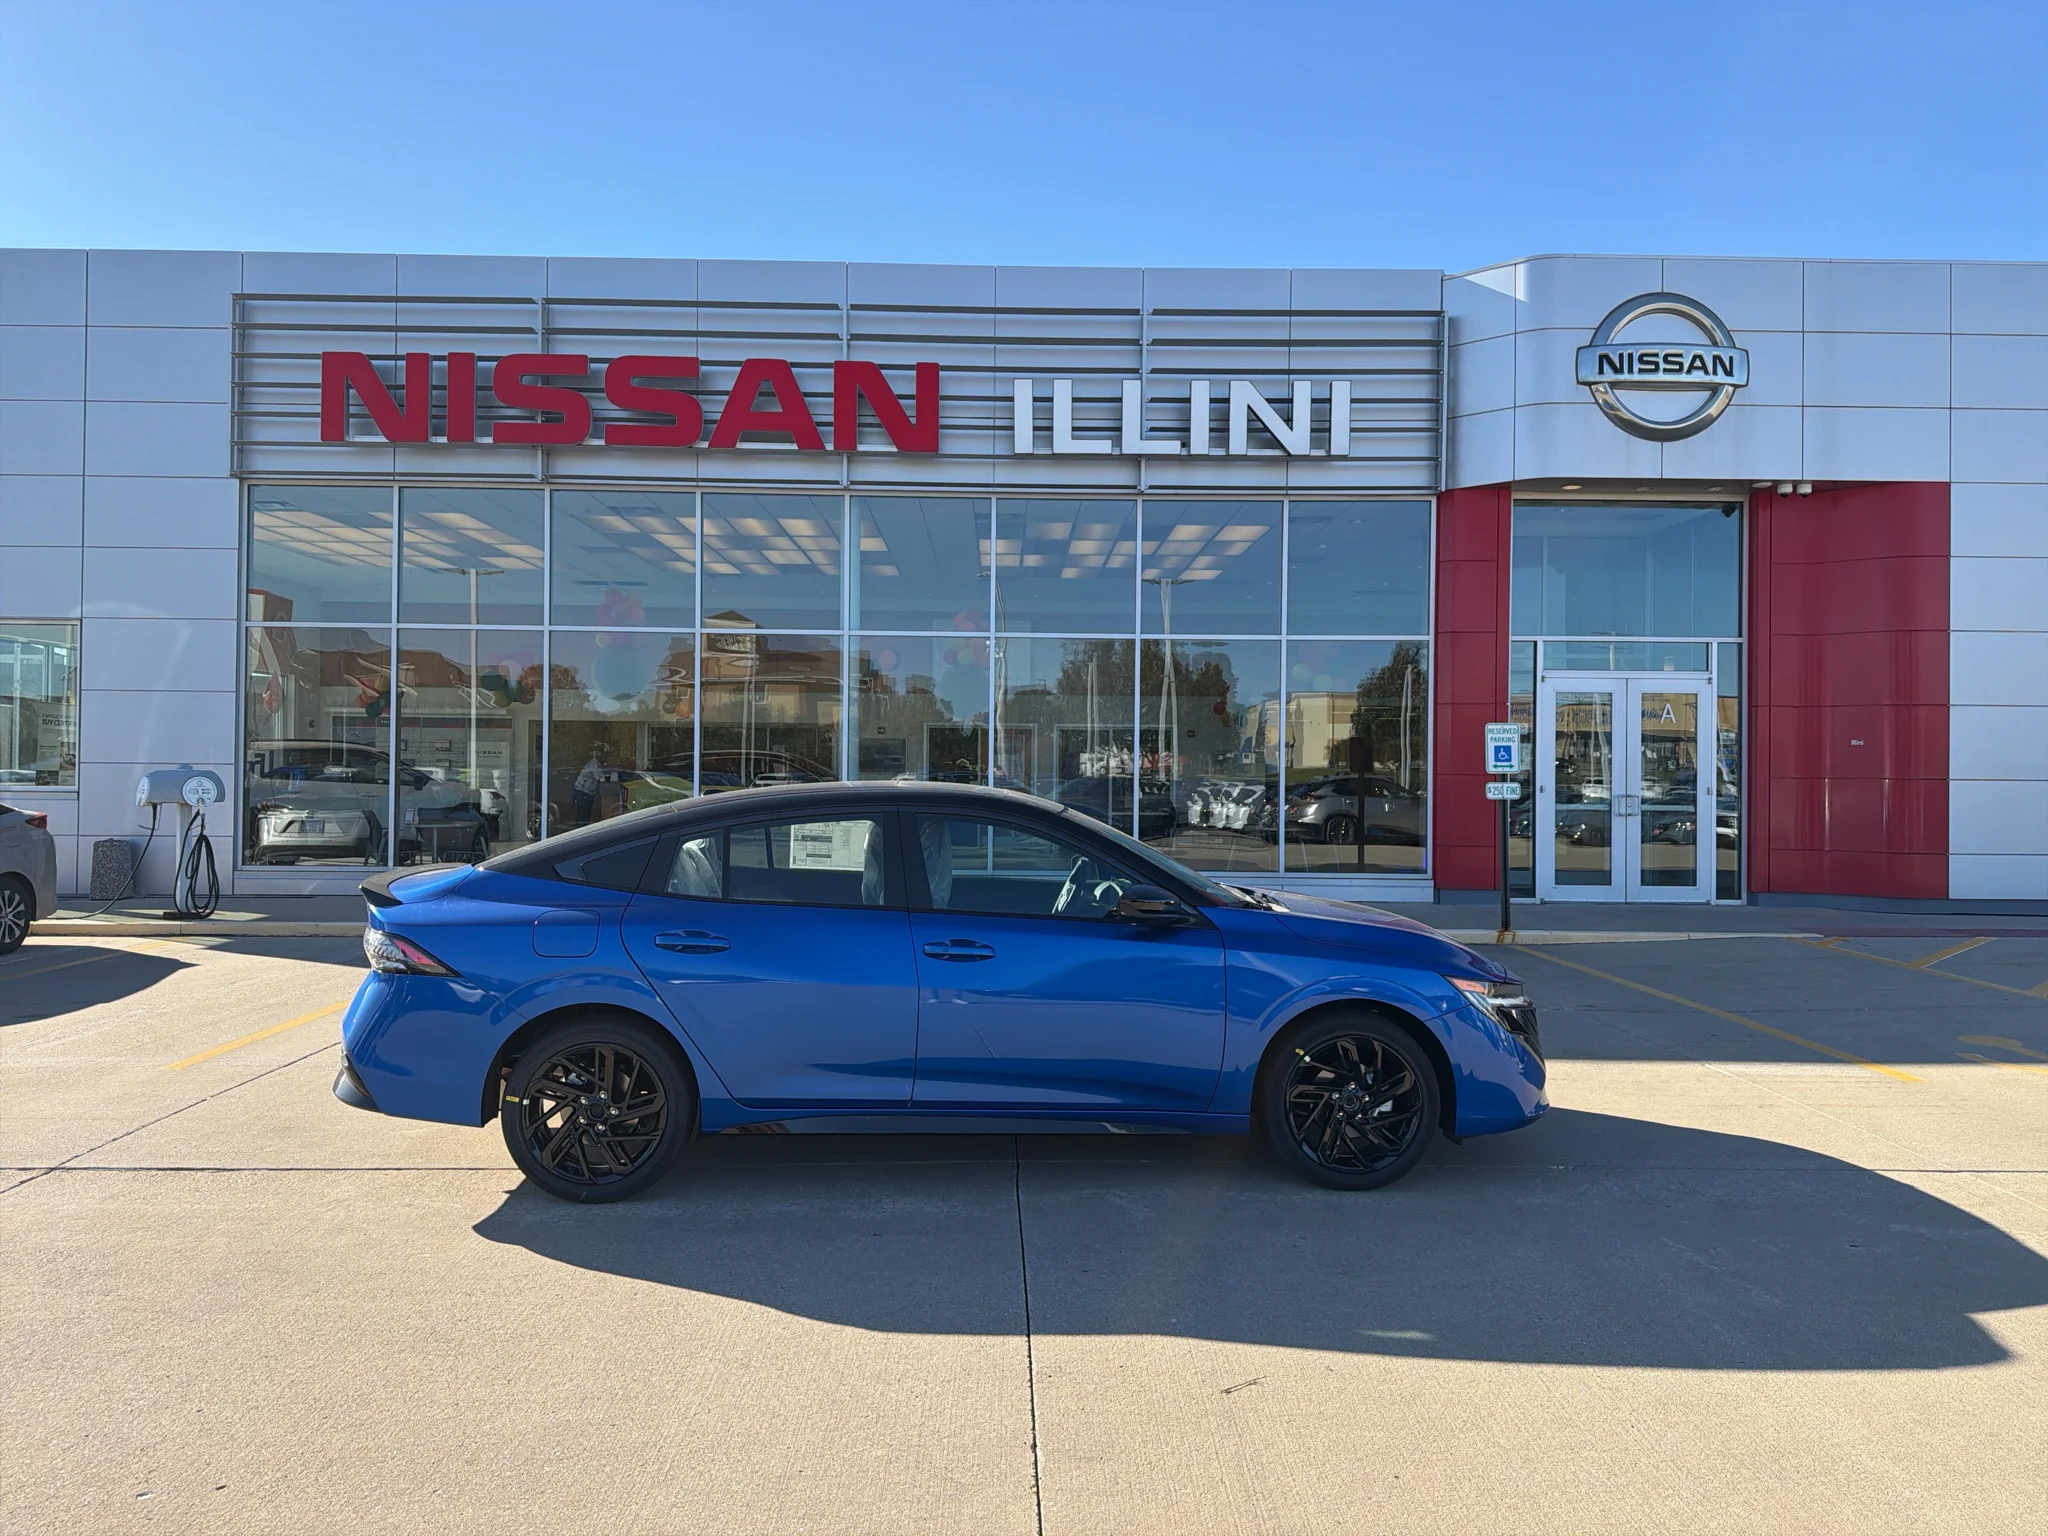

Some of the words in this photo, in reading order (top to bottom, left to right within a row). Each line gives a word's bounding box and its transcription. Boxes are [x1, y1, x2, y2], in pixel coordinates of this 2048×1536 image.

[1597, 352, 1735, 378] NISSAN
[321, 351, 940, 454] NISSAN
[1013, 378, 1351, 456] ILLINI
[1660, 703, 1677, 724] A
[1488, 727, 1518, 735] RESERVED
[1487, 785, 1505, 796] $250
[1506, 785, 1520, 796] FINE
